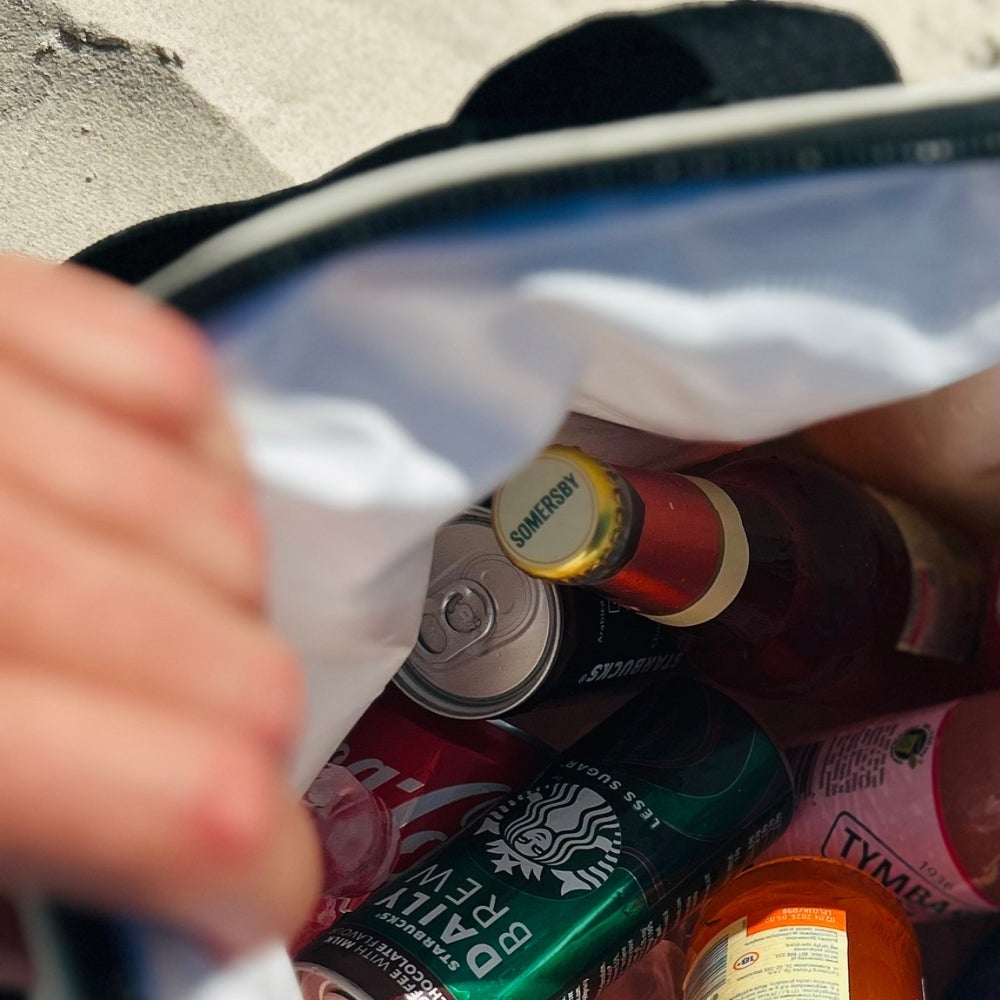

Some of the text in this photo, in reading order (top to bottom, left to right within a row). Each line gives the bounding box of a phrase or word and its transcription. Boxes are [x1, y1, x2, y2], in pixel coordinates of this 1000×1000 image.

[509, 472, 580, 549] SOMERSBY
[565, 760, 661, 829] LESS SUGAR
[840, 827, 948, 915] TYMBA
[323, 935, 358, 950] MILK
[374, 887, 503, 979] DAILY
[379, 912, 461, 971] STARBUCKS
[405, 864, 533, 956] BREW
[353, 944, 391, 972] WITH
